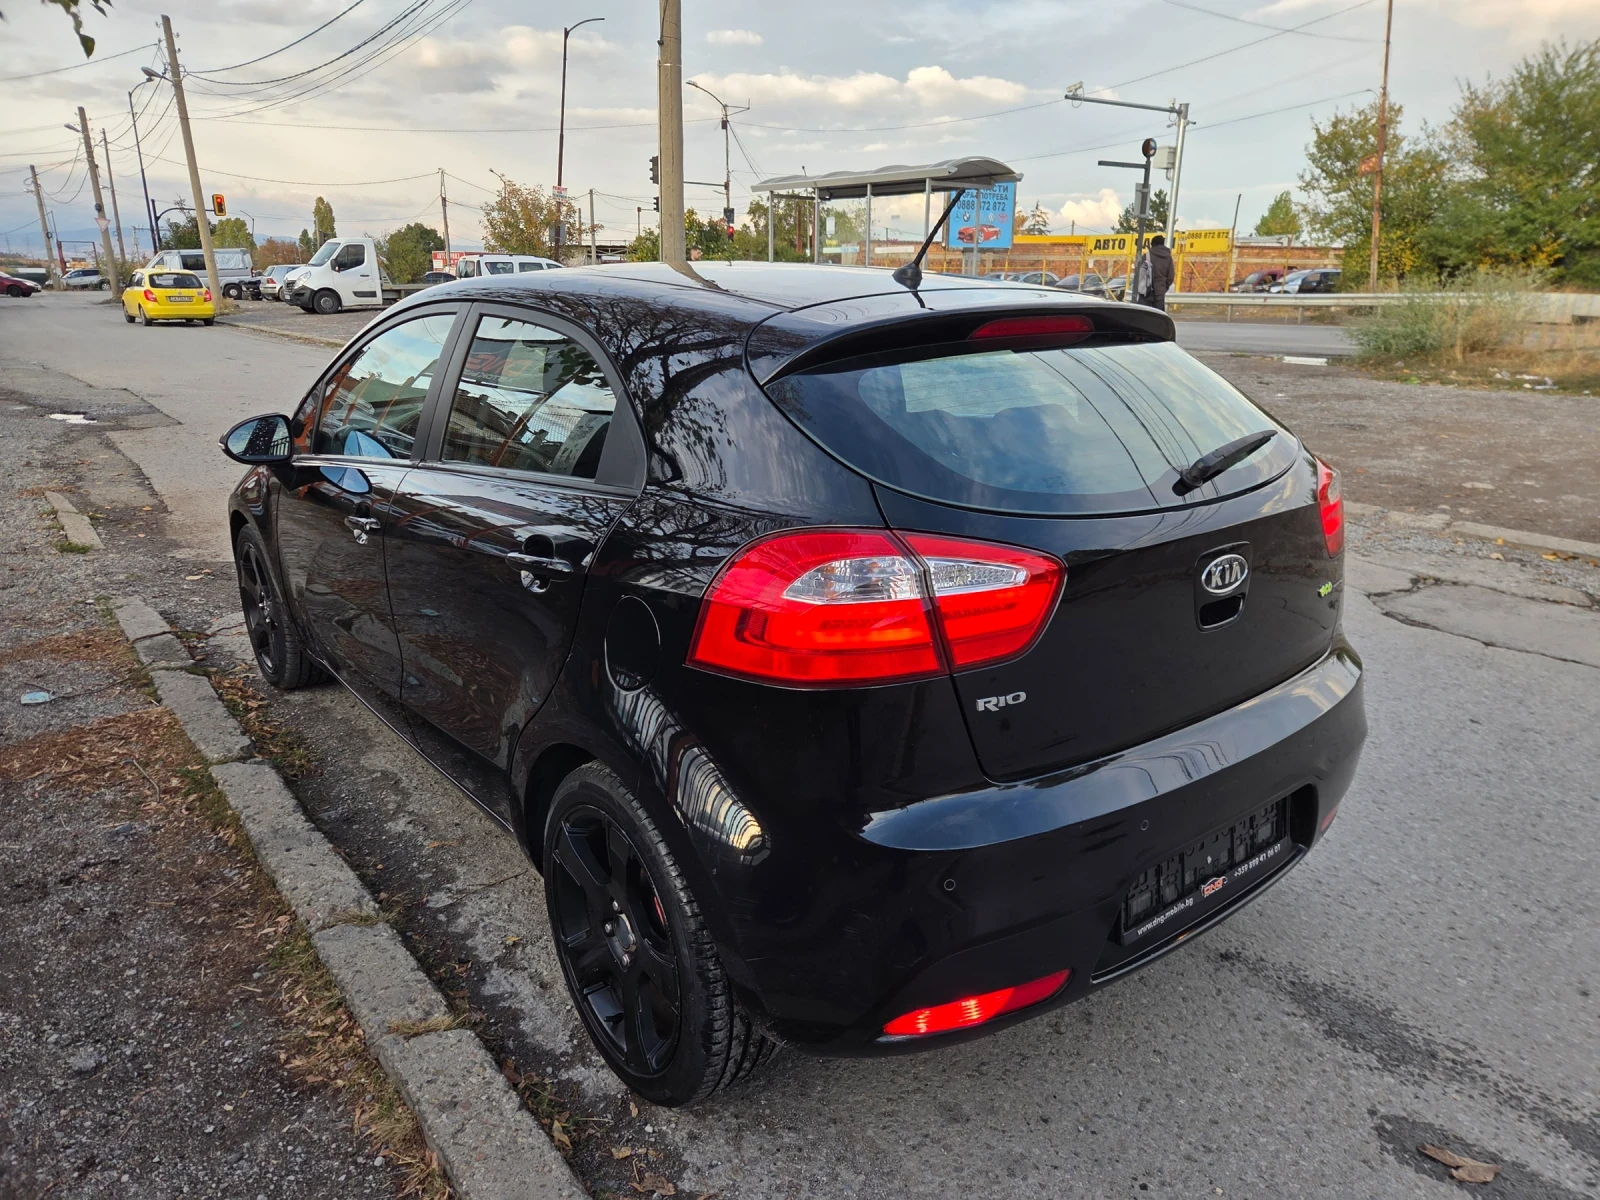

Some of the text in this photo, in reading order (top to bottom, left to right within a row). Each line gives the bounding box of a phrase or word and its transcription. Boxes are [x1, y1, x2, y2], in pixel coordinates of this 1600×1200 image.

[974, 192, 1008, 200] ПОТРЕБА
[977, 201, 991, 211] 72
[1094, 238, 1126, 250] АВТО
[1210, 561, 1241, 588] KIA
[975, 691, 1027, 712] RIO
[1137, 897, 1194, 936] www.dng.mobile.bg
